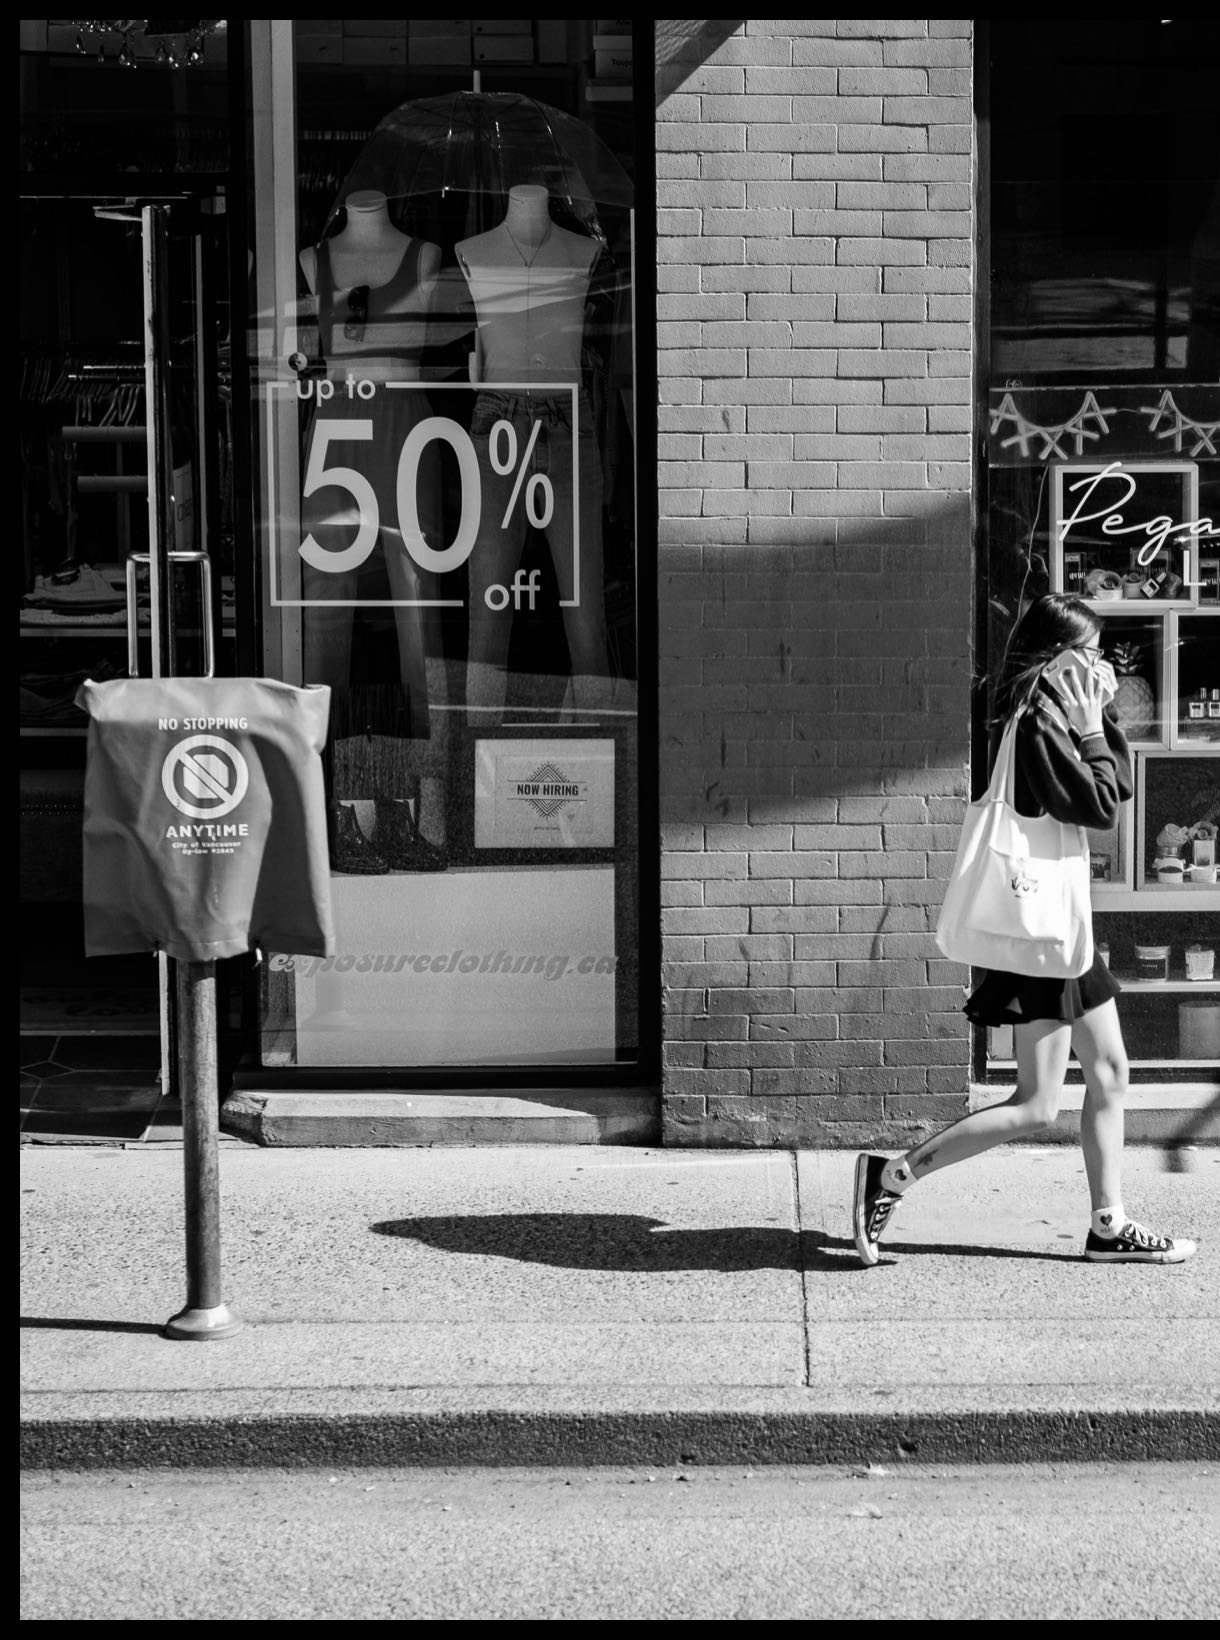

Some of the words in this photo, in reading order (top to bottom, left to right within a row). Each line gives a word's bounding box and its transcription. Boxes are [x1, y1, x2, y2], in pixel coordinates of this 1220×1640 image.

[295, 378, 335, 407] up
[345, 373, 377, 400] to
[297, 416, 555, 574] 50%
[484, 569, 541, 611] off
[158, 718, 178, 731] NO
[183, 717, 249, 730] STOPPING
[517, 783, 540, 796] NOW
[542, 784, 579, 796] HIRING
[166, 824, 249, 838] ANYTIME
[268, 949, 619, 982] exposureclothing.ca
